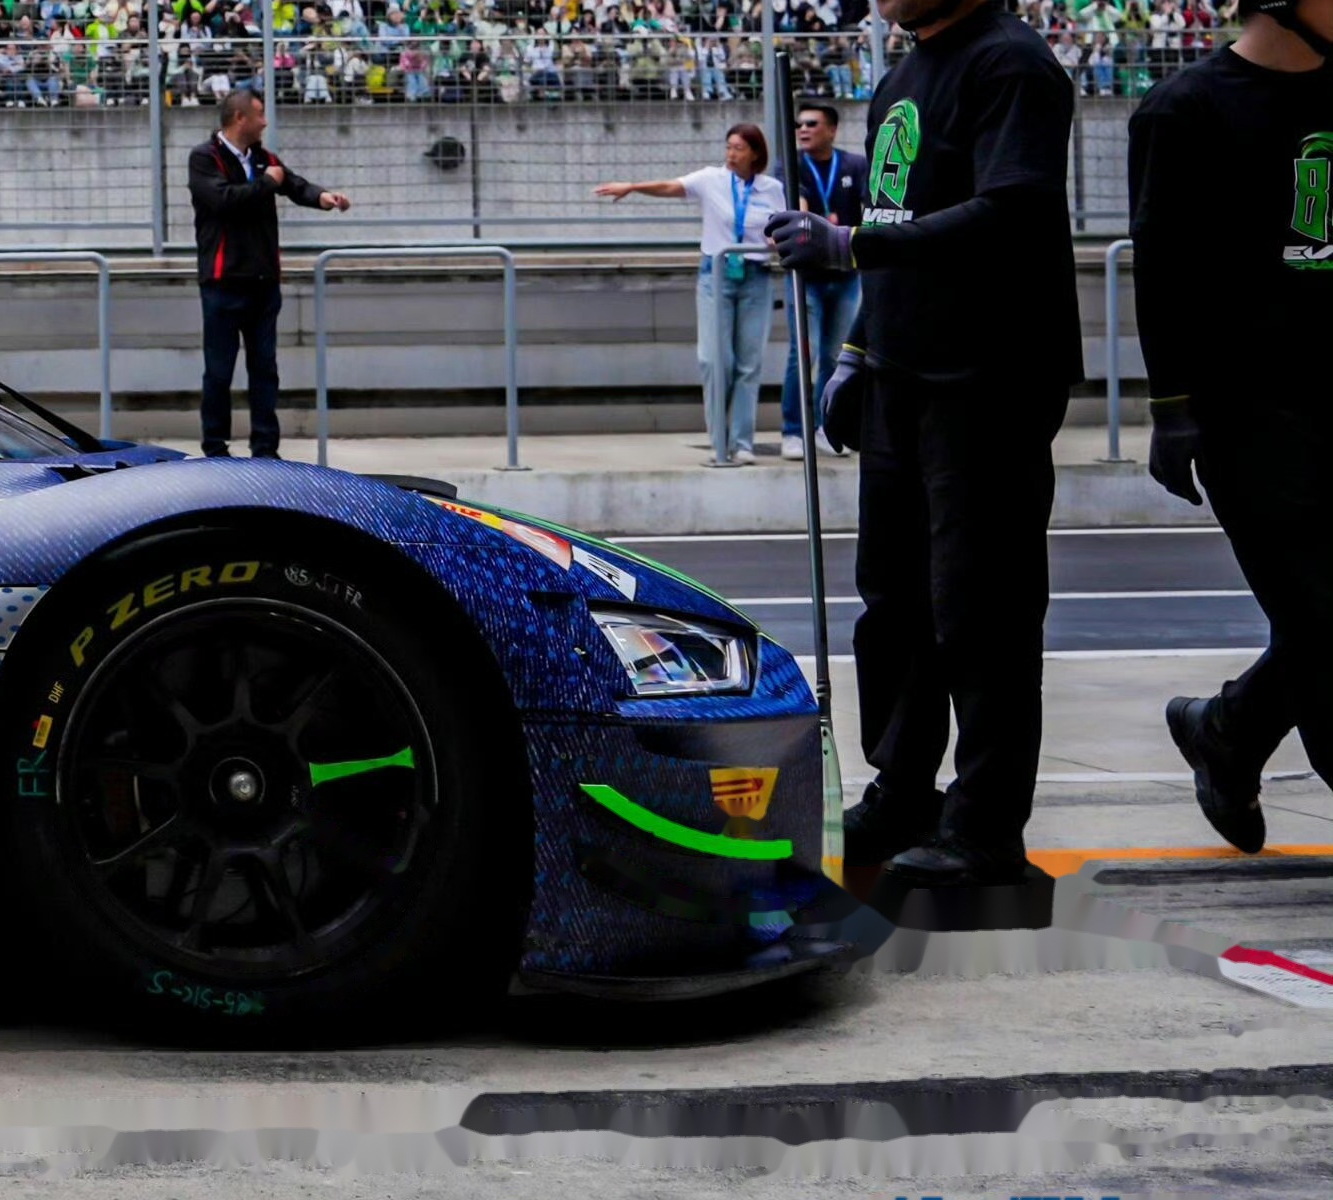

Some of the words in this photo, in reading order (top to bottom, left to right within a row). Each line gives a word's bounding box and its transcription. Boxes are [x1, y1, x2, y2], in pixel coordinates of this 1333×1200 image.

[862, 207, 913, 224] VISU
[69, 626, 93, 667] P
[106, 561, 261, 631] ZERO
